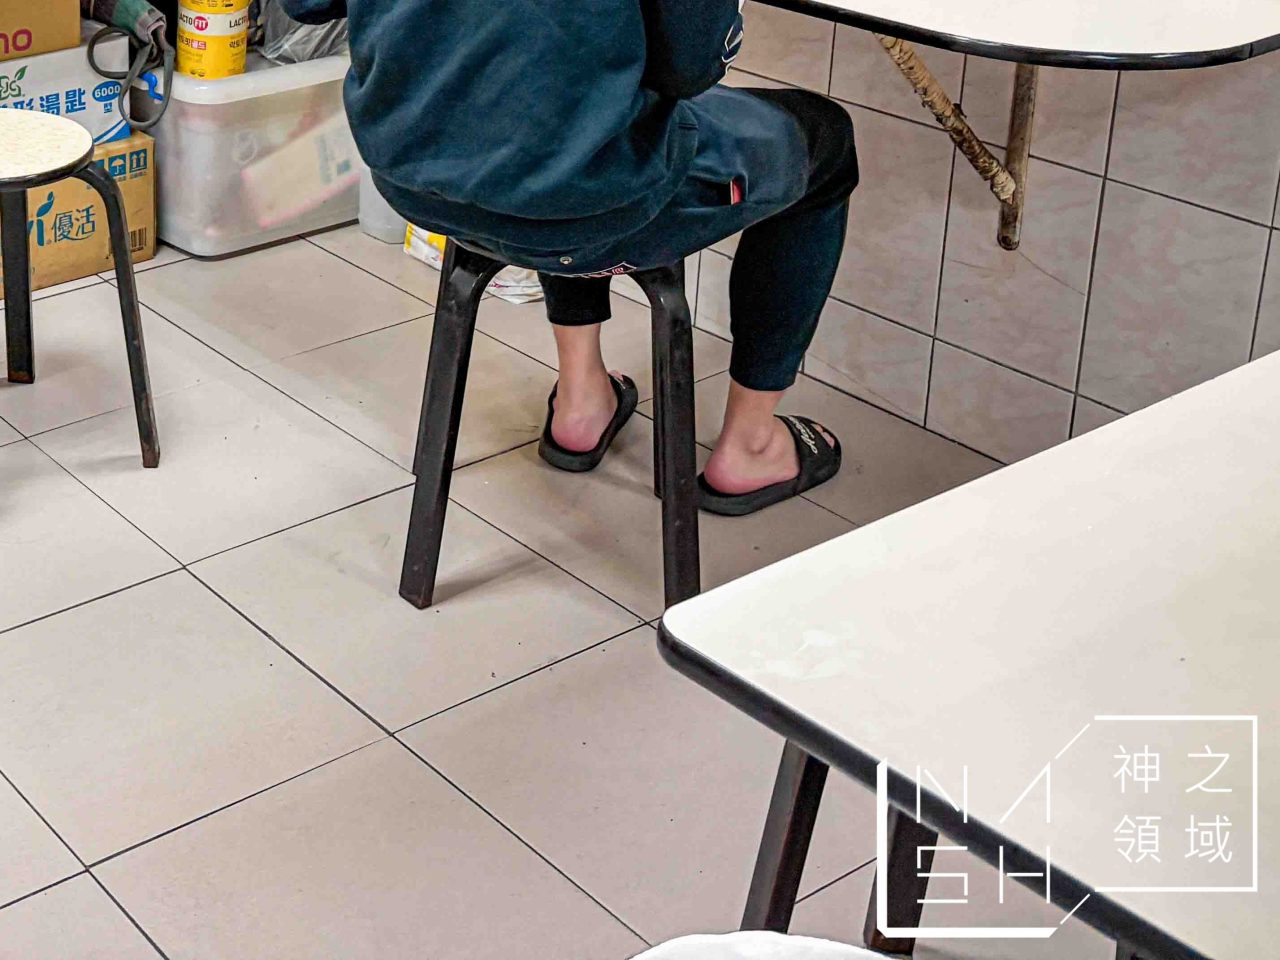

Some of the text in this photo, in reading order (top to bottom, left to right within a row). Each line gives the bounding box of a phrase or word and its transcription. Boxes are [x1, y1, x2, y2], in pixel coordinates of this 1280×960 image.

[179, 12, 207, 29] ACTO FIT
[94, 85, 120, 98] 6000
[51, 205, 95, 243] 優活
